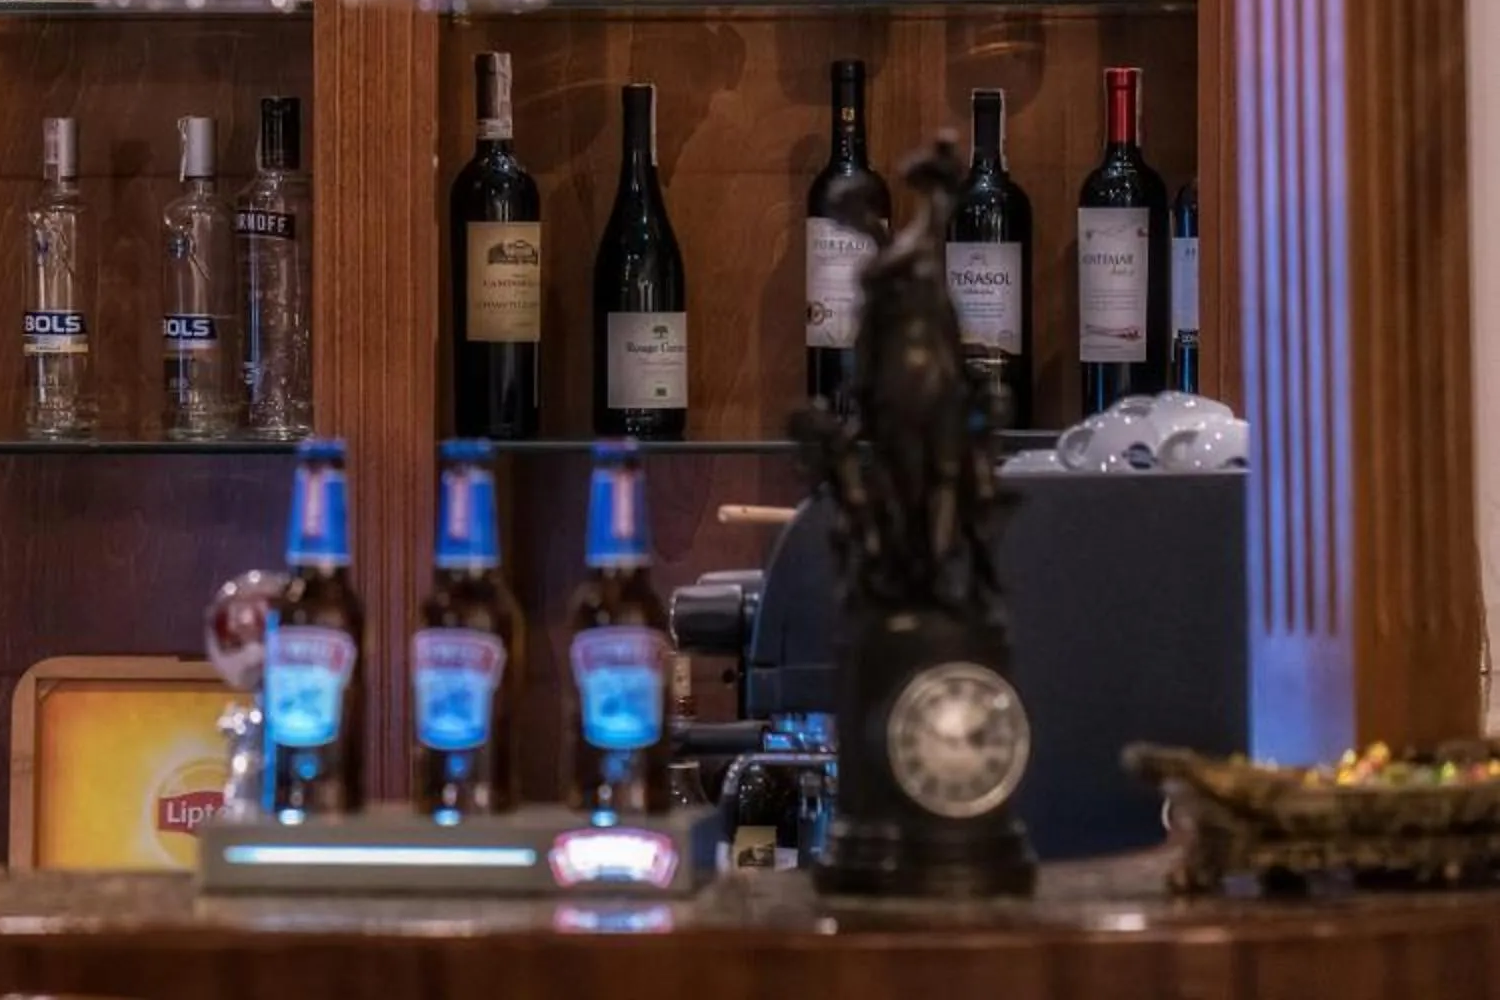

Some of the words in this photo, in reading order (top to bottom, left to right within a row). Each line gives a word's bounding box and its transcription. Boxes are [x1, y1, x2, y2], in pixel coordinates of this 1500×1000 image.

[238, 214, 287, 233] RNOFF
[24, 315, 82, 333] BOLS
[166, 800, 227, 830] Lipt
